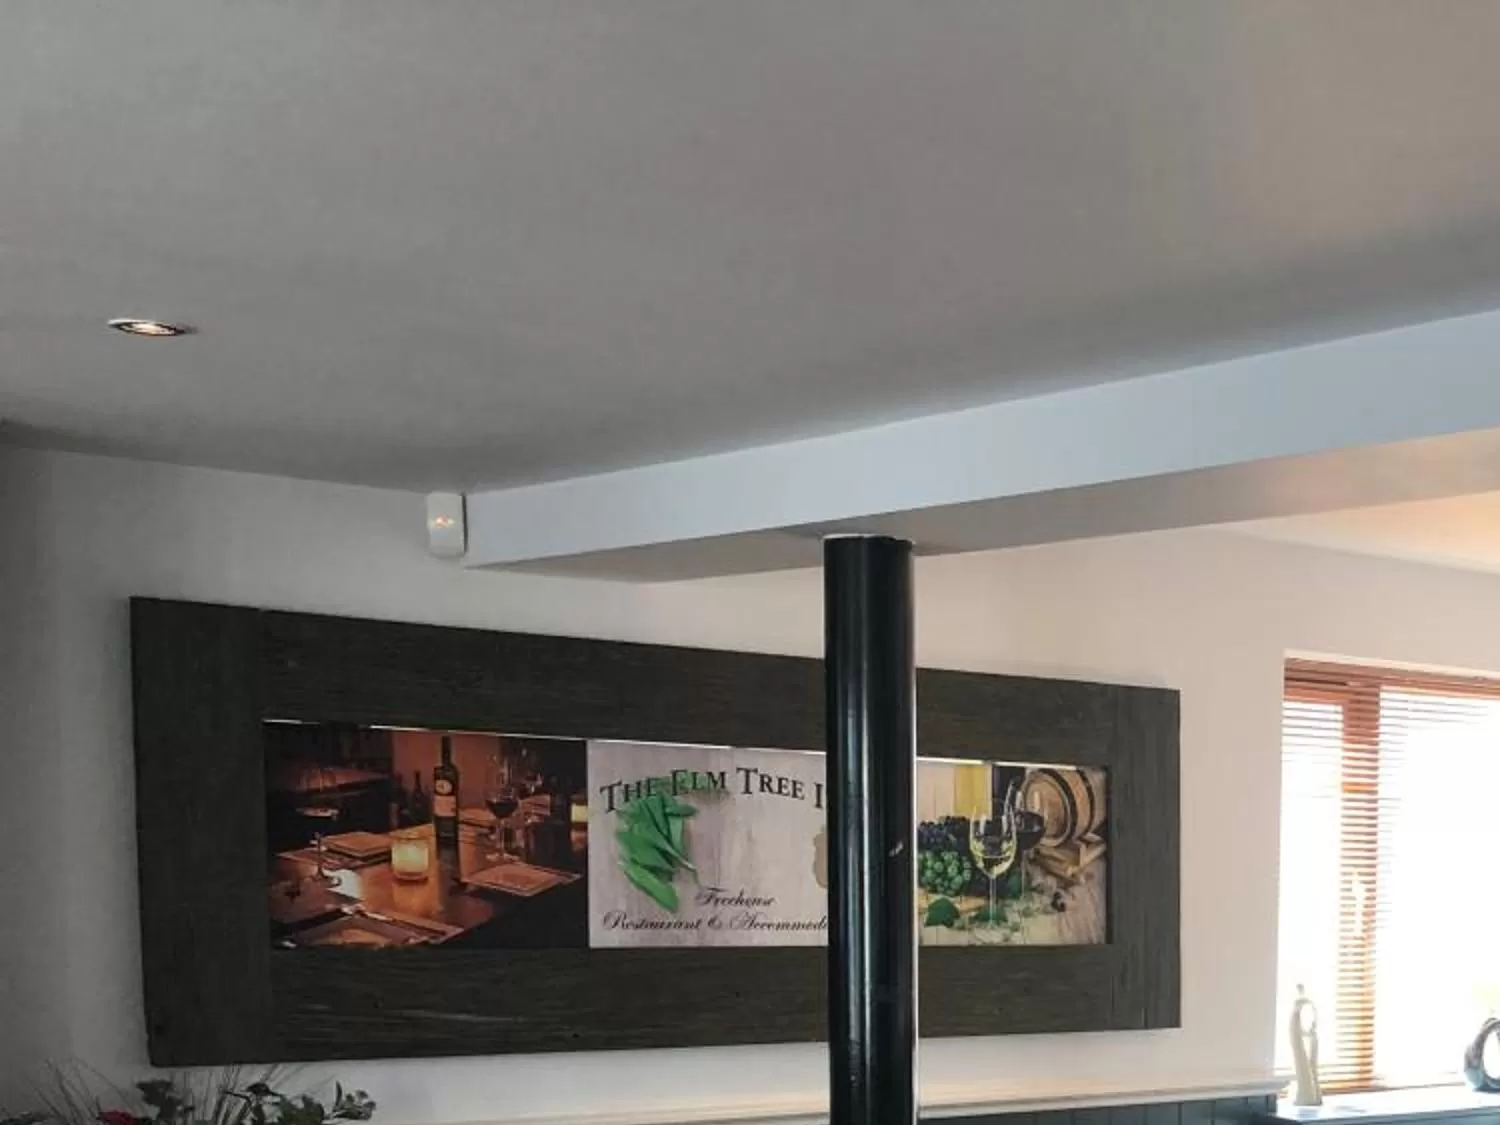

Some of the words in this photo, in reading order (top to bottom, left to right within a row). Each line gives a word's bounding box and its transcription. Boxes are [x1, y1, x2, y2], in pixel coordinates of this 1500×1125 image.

[600, 778, 662, 812] THE
[671, 767, 727, 796] ELM
[736, 767, 805, 801] TREE
[602, 909, 703, 931] Restaurant
[730, 911, 828, 931] Accommod
